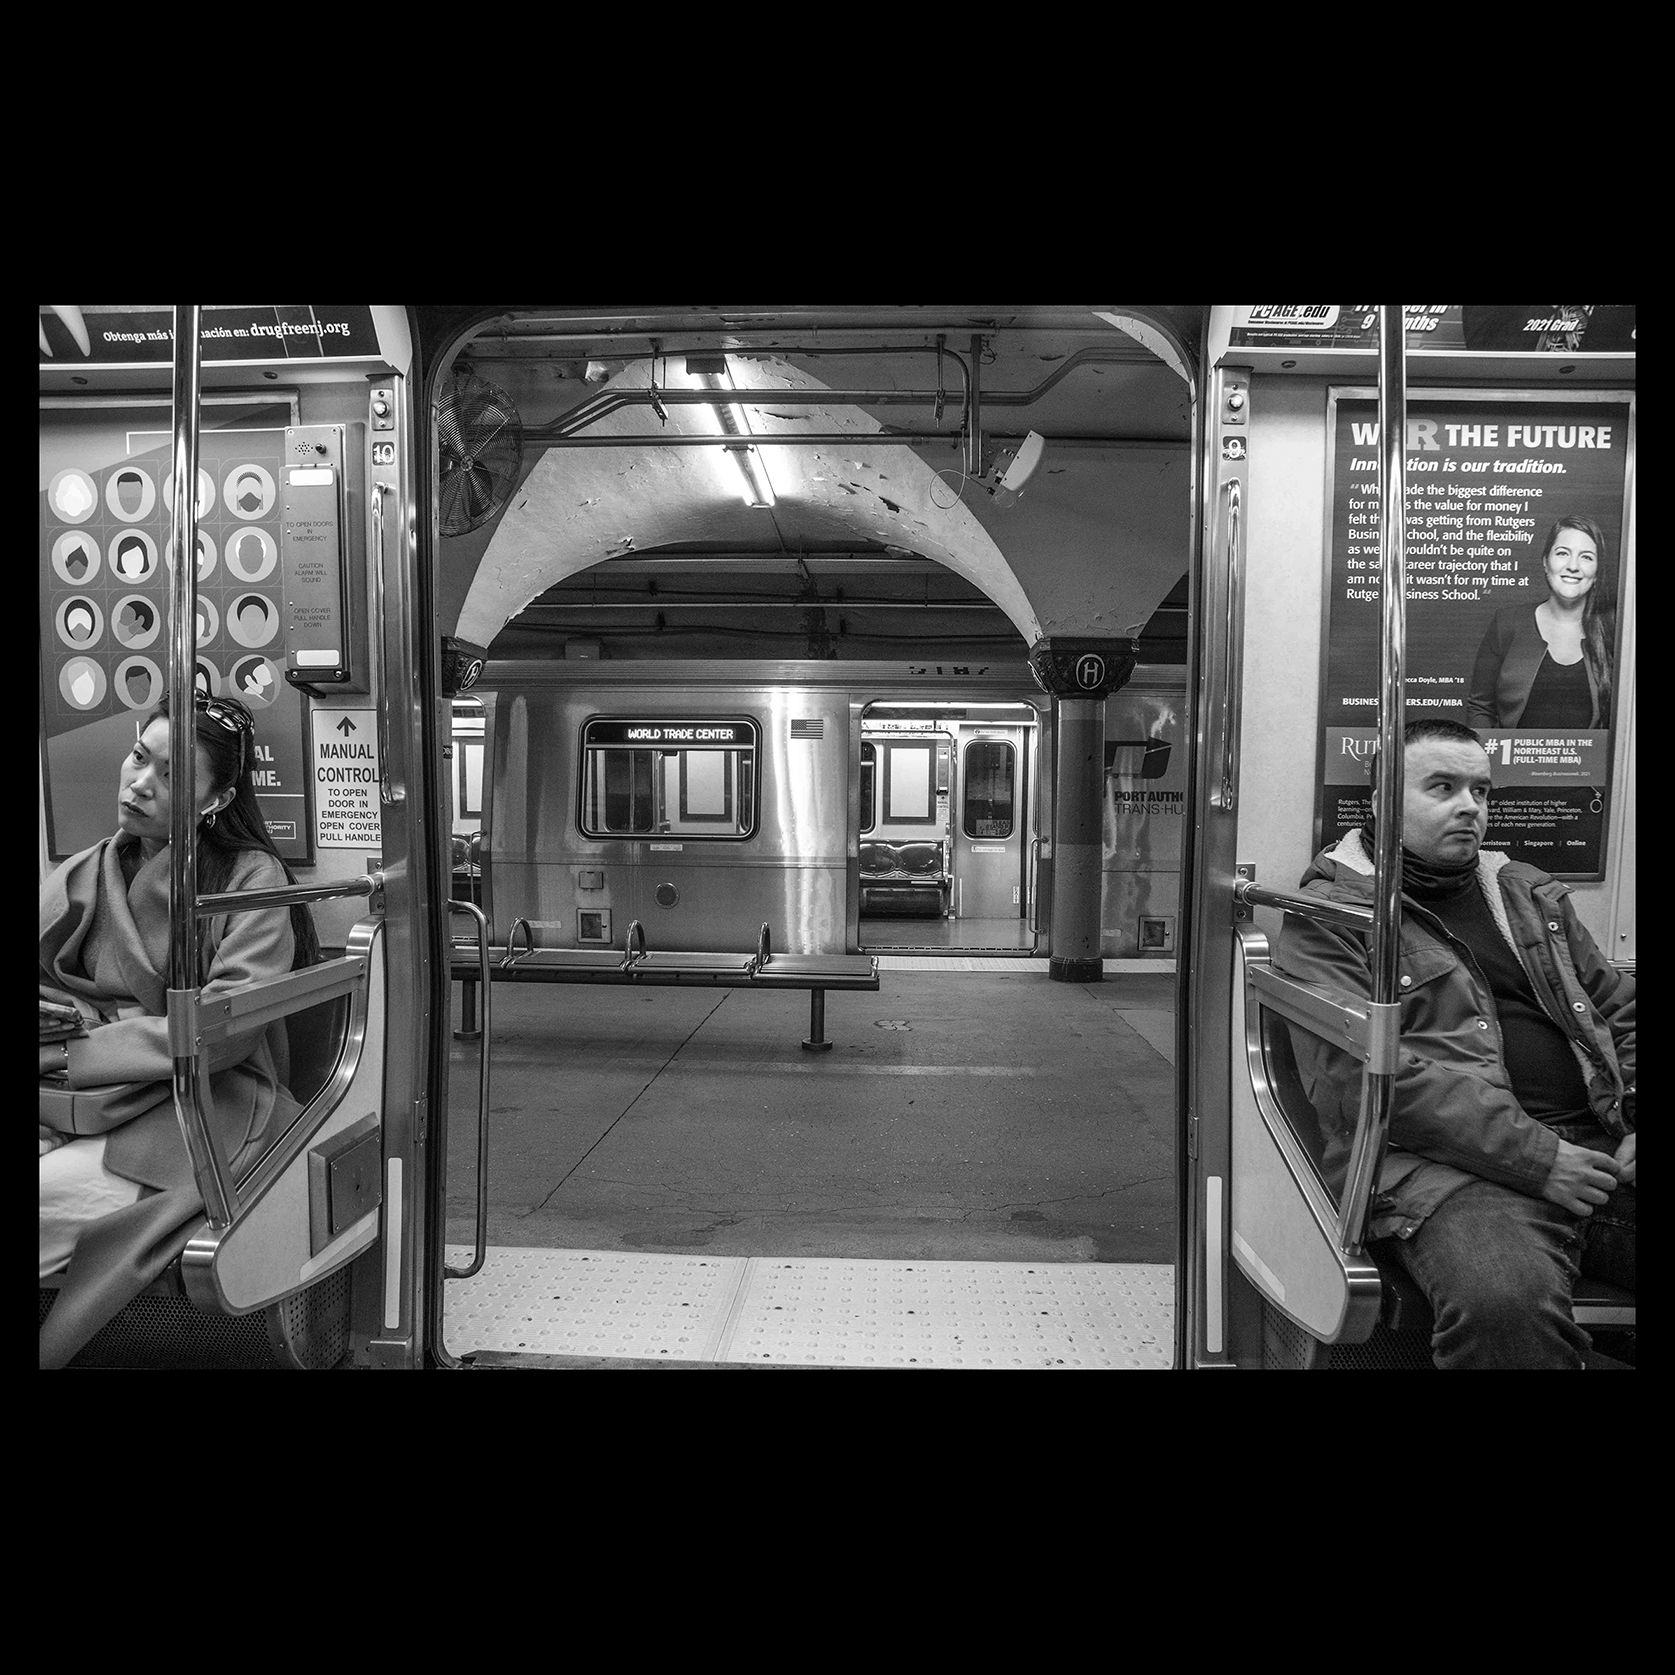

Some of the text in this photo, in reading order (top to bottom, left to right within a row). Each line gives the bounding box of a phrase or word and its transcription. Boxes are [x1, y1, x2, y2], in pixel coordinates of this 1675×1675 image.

[1360, 313, 1376, 330] 9
[1522, 319, 1580, 331] 2021 Grad
[103, 331, 147, 343] Obtenga
[146, 329, 169, 341] más
[250, 319, 351, 338] drugfreenj.org
[1444, 424, 1499, 448] THE
[1507, 425, 1612, 449] FUTURE
[373, 444, 394, 463] 10
[1349, 457, 1567, 474] Inntion is our tradition.
[1404, 484, 1424, 496] ade
[1427, 484, 1446, 496] the
[1448, 484, 1488, 499] biggest
[1489, 485, 1543, 497] difference
[1348, 498, 1366, 510] for
[1414, 499, 1433, 511] the
[1434, 499, 1465, 511] value
[1466, 500, 1483, 511] for
[1484, 502, 1523, 515] money
[1524, 501, 1530, 513] I
[1348, 513, 1368, 525] felt
[1425, 514, 1464, 529] getting
[1466, 514, 1492, 527] from
[1494, 516, 1536, 530] Rutgers
[1348, 529, 1535, 545] Busin chool, and the flexibility
[1347, 546, 1361, 556] as
[1405, 543, 1448, 556] ouldn’t
[1449, 544, 1465, 557] be
[1466, 545, 1495, 559] quite
[1497, 548, 1512, 557] on
[1347, 558, 1366, 571] the
[1438, 560, 1489, 574] trajectory
[1490, 560, 1512, 572] that
[1514, 561, 1520, 572] I
[1346, 576, 1366, 586] am
[1406, 573, 1414, 586] it
[1453, 574, 1470, 586] for
[1471, 577, 1490, 589] my
[1491, 575, 1516, 587] time
[1517, 576, 1530, 587] at
[1346, 589, 1380, 603] Rutge
[1406, 588, 1440, 600] siness
[627, 728, 734, 740] WORLD TRADE CENTER
[319, 743, 375, 760] MANUAL
[1484, 738, 1593, 765] #1 PUBLIC MBA IN THE
[1513, 747, 1578, 756] NORTHEAST U.S.
[1513, 755, 1582, 766] (FULL-TIME MBA)
[317, 766, 380, 784] CONTROL
[327, 788, 368, 797] TO OPEN
[1114, 790, 1147, 803] PORT
[328, 800, 369, 808] DOOR IN
[321, 810, 378, 820] EMERGENCY
[319, 822, 381, 831] OPEN COVER
[319, 833, 382, 843] PULL HANDLE
[1523, 840, 1554, 848] Singapore
